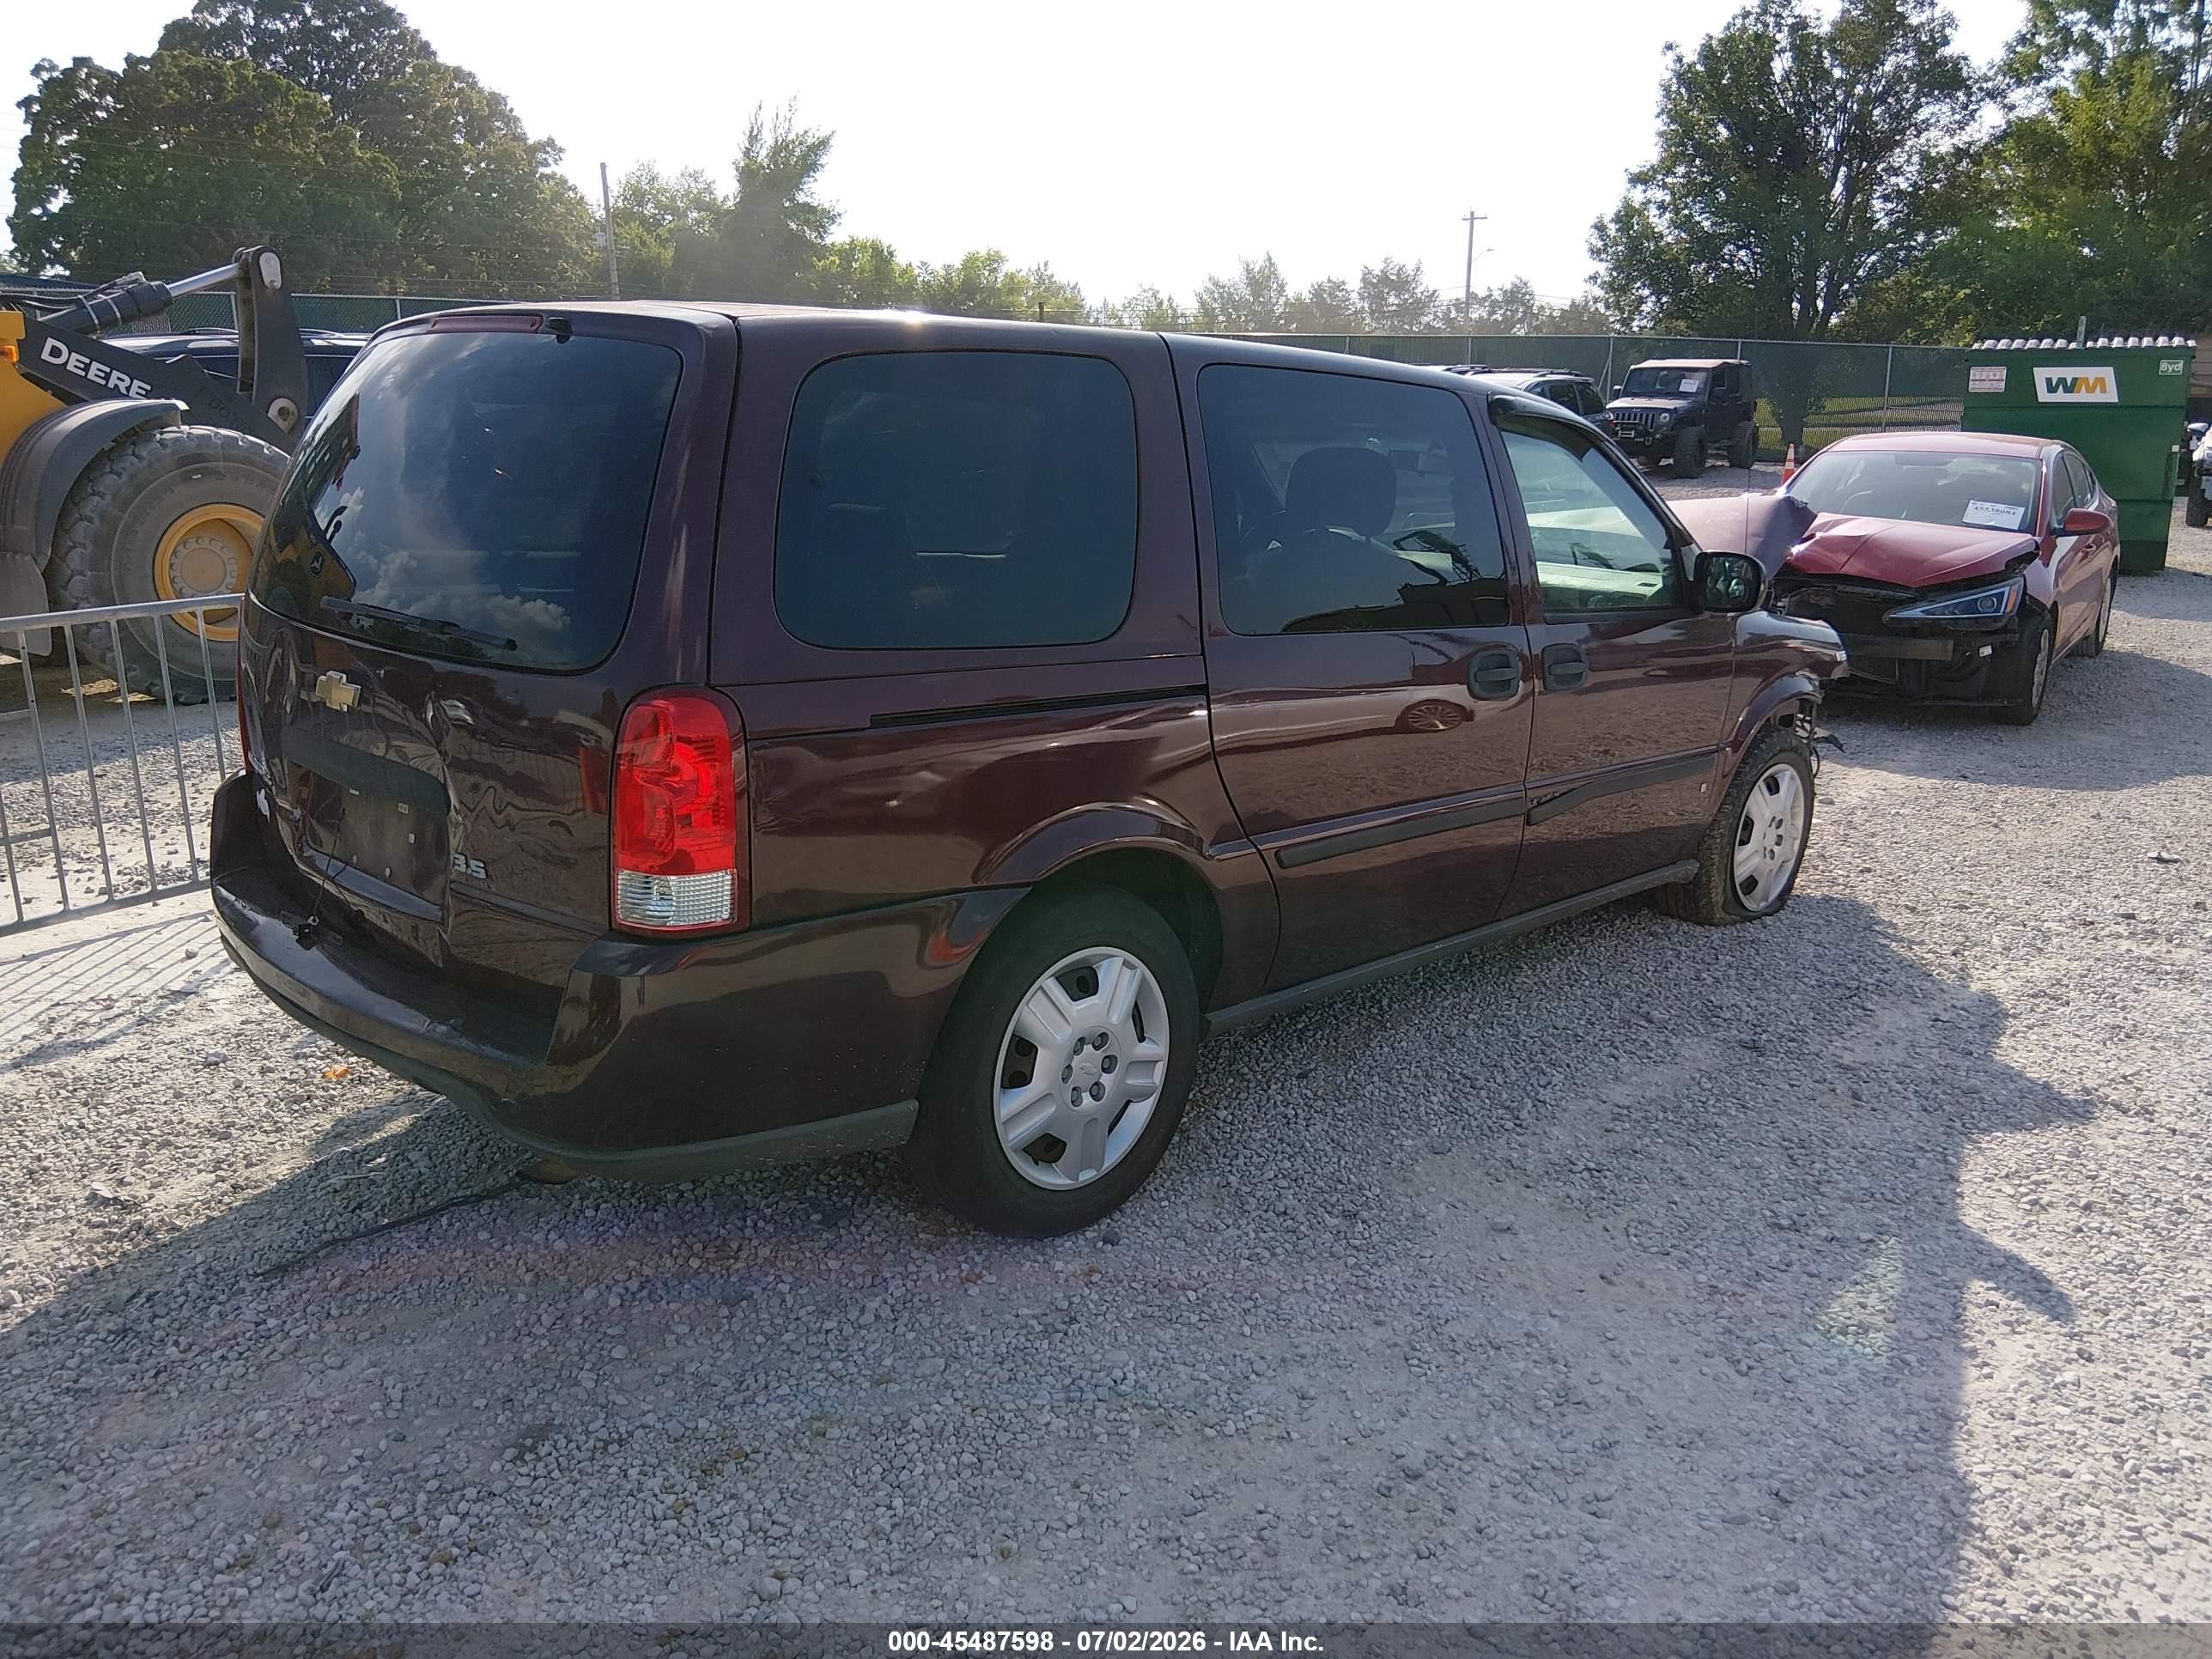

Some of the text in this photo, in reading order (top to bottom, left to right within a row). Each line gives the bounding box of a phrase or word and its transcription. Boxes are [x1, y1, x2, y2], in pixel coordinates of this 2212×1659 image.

[40, 336, 152, 399] DEERE
[2160, 362, 2182, 374] 8yd
[2045, 377, 2106, 393] WM
